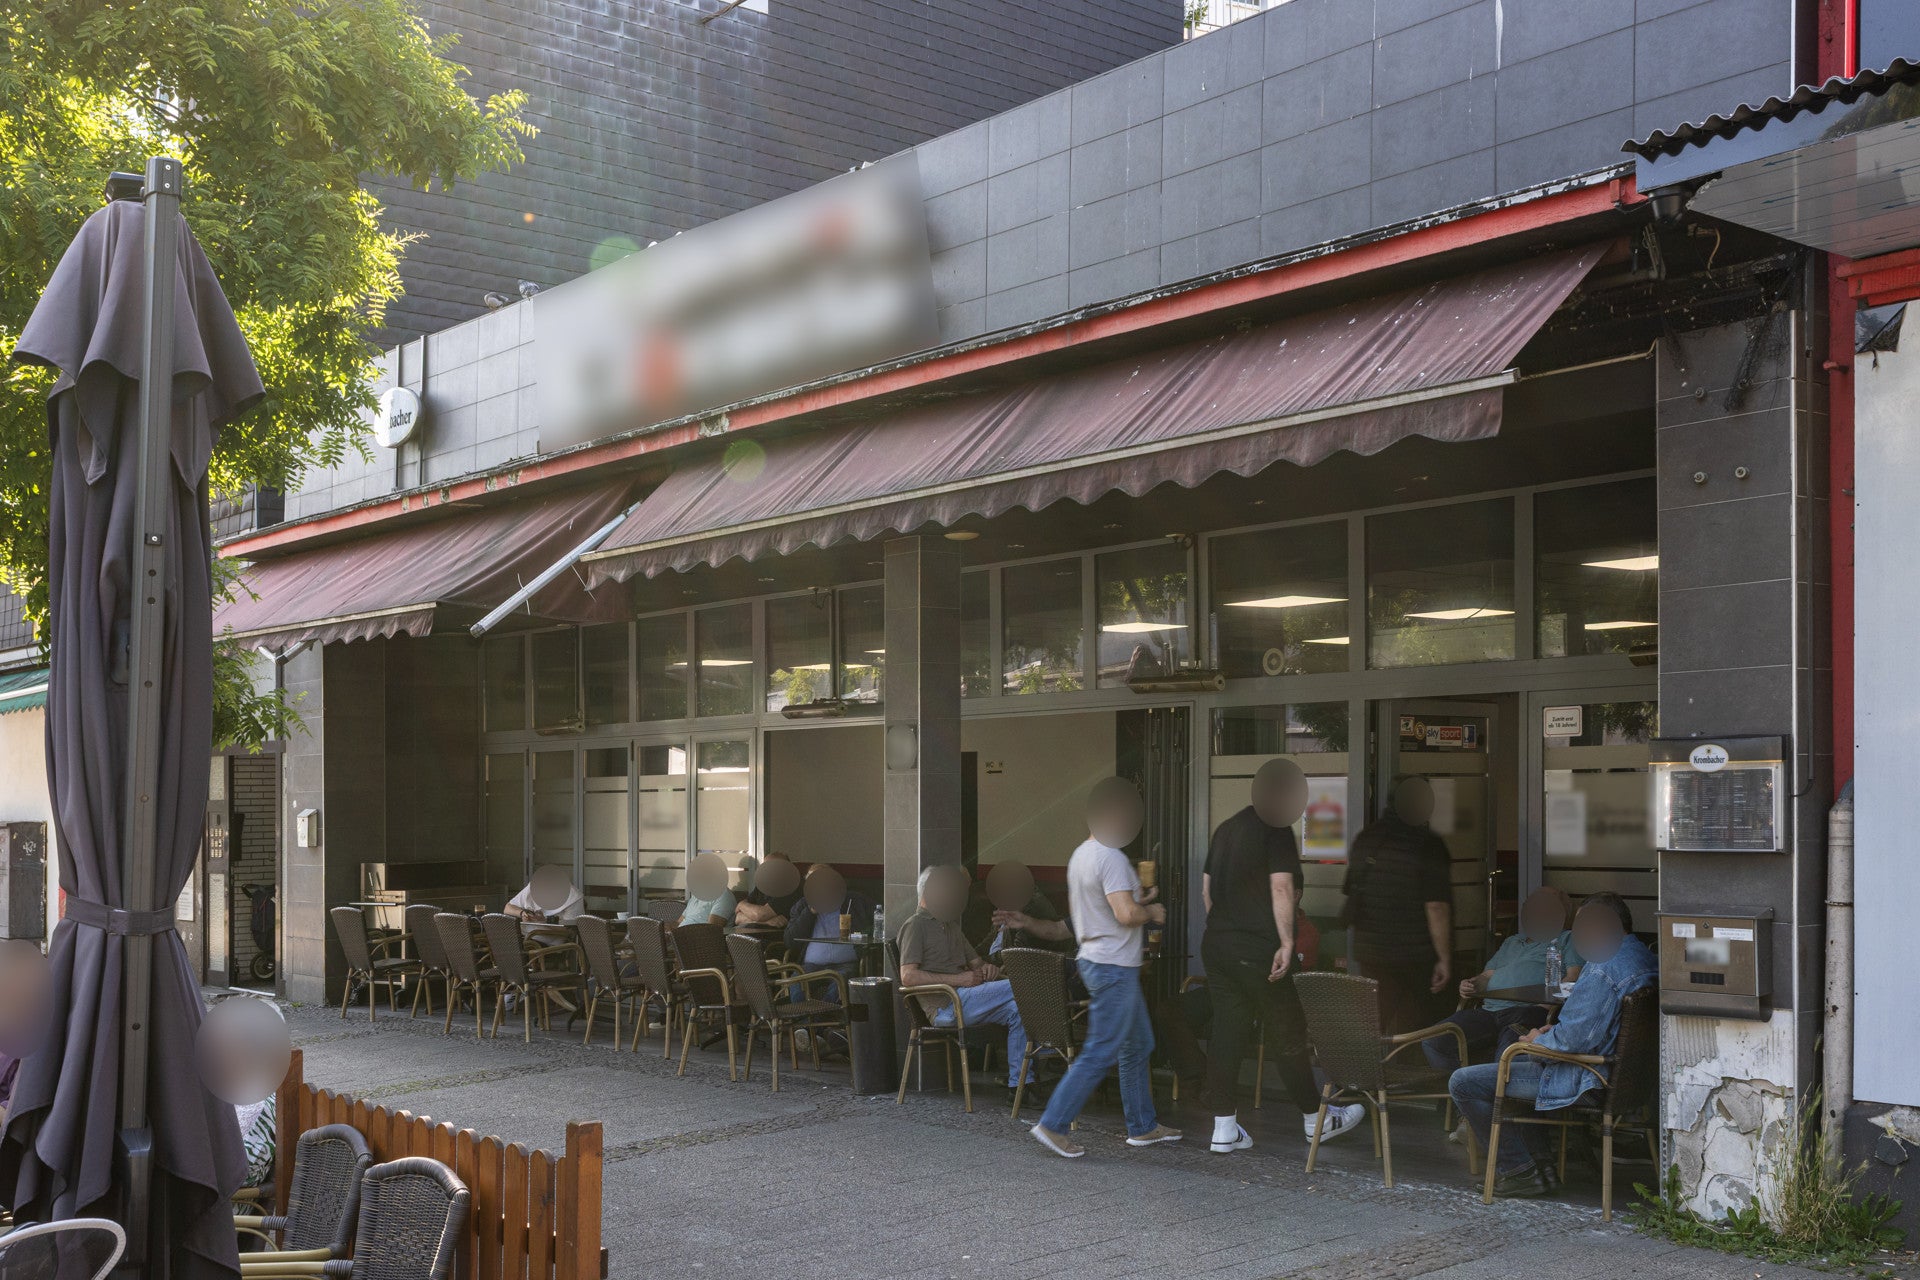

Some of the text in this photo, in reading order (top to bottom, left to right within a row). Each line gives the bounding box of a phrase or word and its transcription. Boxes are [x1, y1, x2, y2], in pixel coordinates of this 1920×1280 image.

[1427, 728, 1439, 739] sky
[1441, 729, 1461, 738] sport
[1693, 755, 1725, 763] Krombacher
